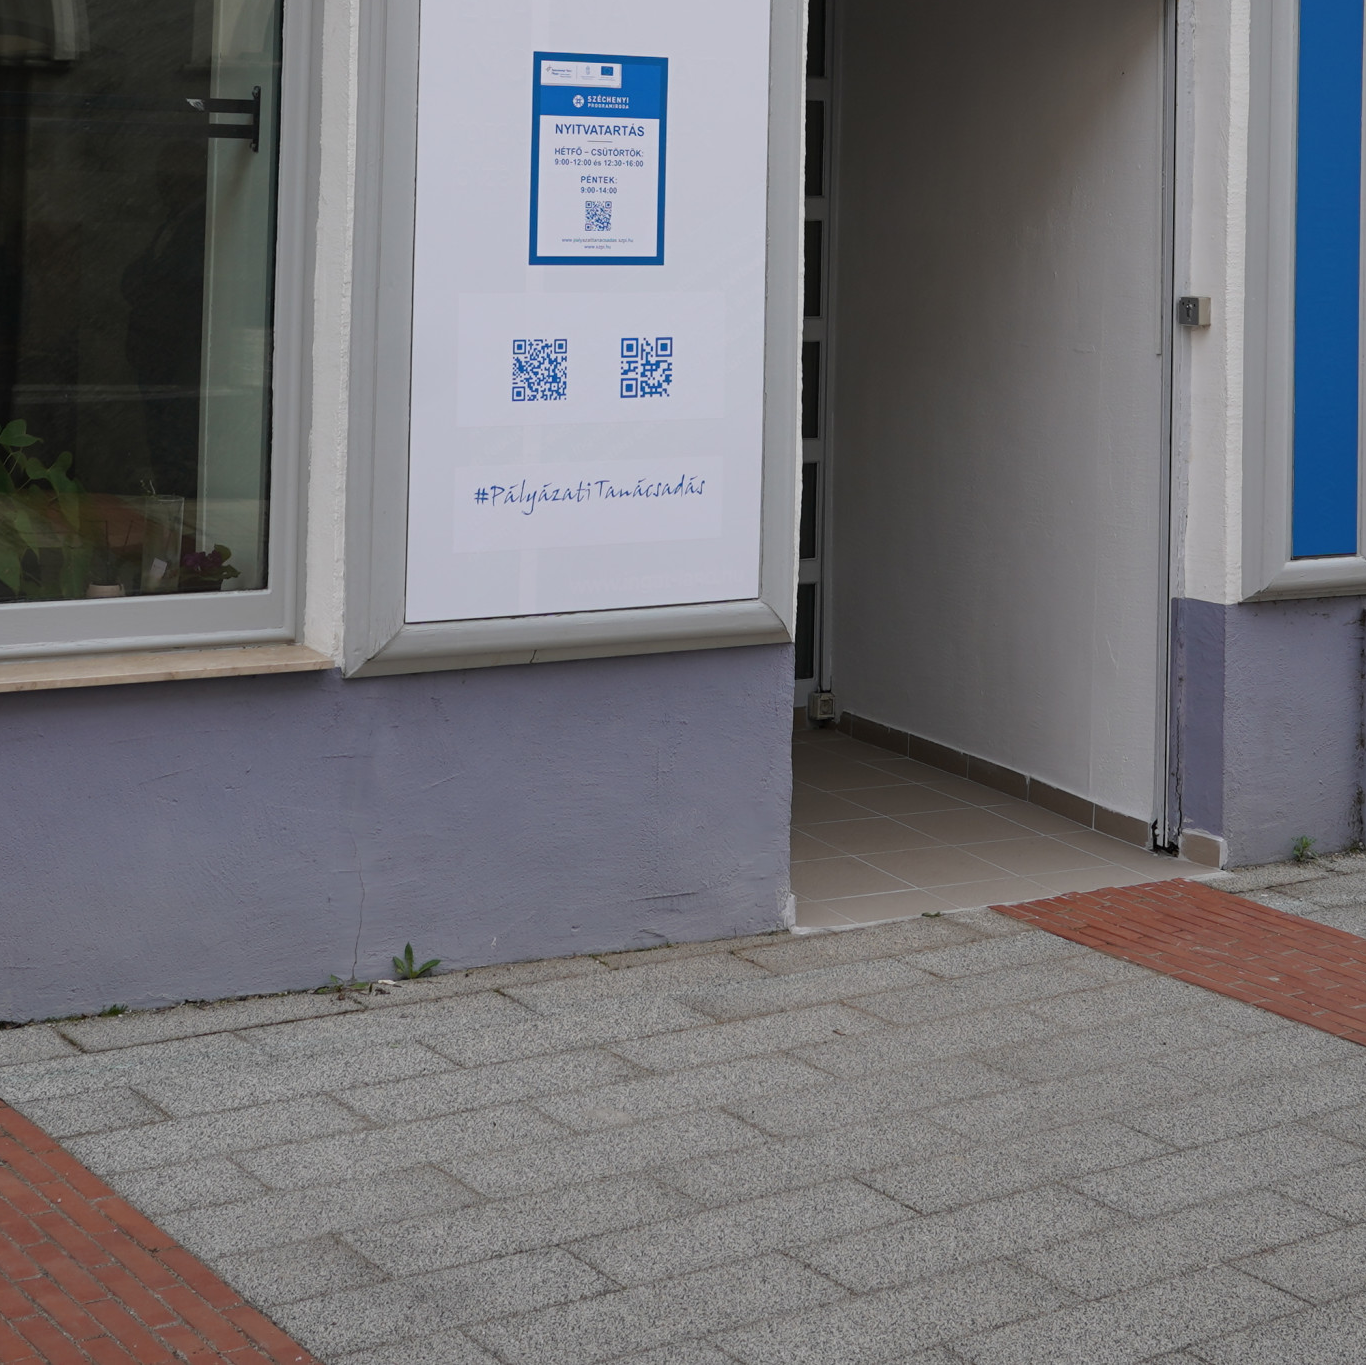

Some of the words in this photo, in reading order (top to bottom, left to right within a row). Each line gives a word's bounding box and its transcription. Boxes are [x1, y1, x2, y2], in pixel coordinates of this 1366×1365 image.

[588, 95, 629, 103] SZÉCHENYI
[556, 124, 645, 137] NYITVATARTÁS
[591, 148, 644, 157] CSÜTÖRTÖK:
[581, 176, 618, 184] PÉNTEK:
[474, 473, 707, 515] #PályázatiTanácsadás
